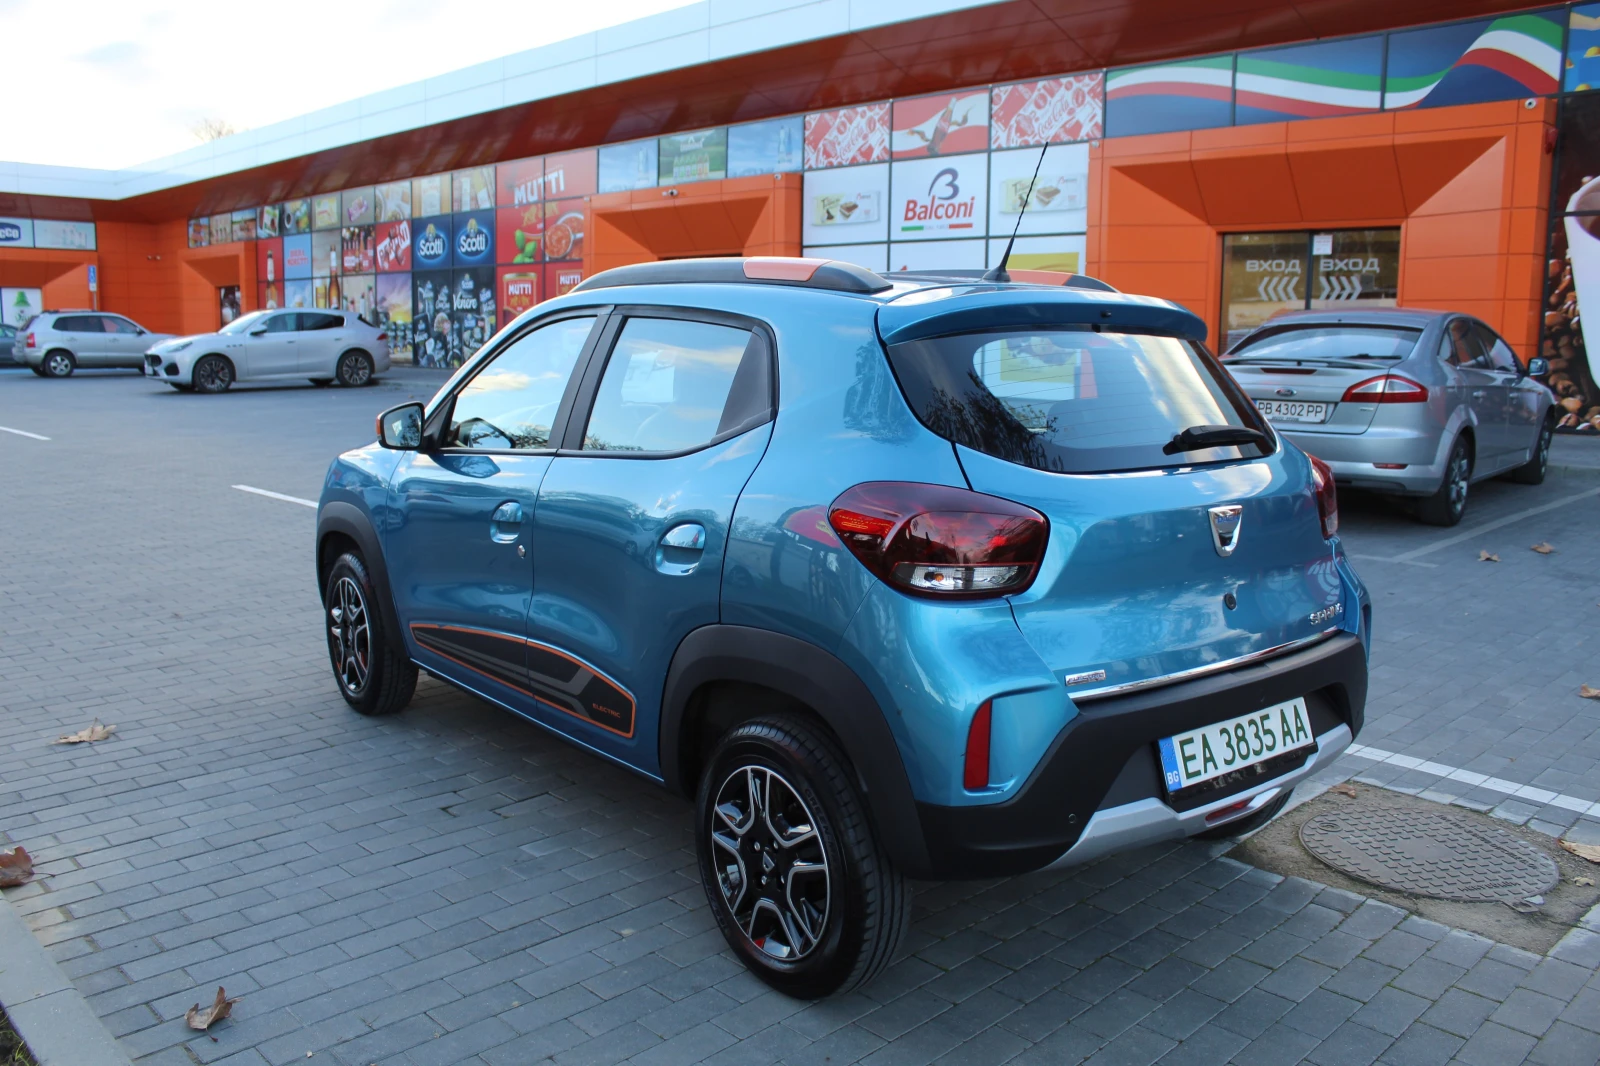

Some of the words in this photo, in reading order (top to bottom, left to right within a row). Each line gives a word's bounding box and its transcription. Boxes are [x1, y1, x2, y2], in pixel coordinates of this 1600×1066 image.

[514, 169, 565, 208] MUTTI
[903, 195, 975, 222] Balconi
[418, 238, 444, 256] Scotti
[460, 234, 486, 253] Scotti
[1246, 259, 1302, 274] ВХОД
[1319, 258, 1380, 273] ВХОД
[559, 275, 581, 285] MUTTI
[508, 283, 532, 296] MUTTI
[452, 291, 478, 311] Venere
[1275, 403, 1304, 417] 4302
[1306, 405, 1323, 417] PP
[1179, 733, 1218, 780] EA
[1219, 714, 1277, 766] 3835
[1279, 704, 1309, 747] AA
[1166, 770, 1180, 785] BG
